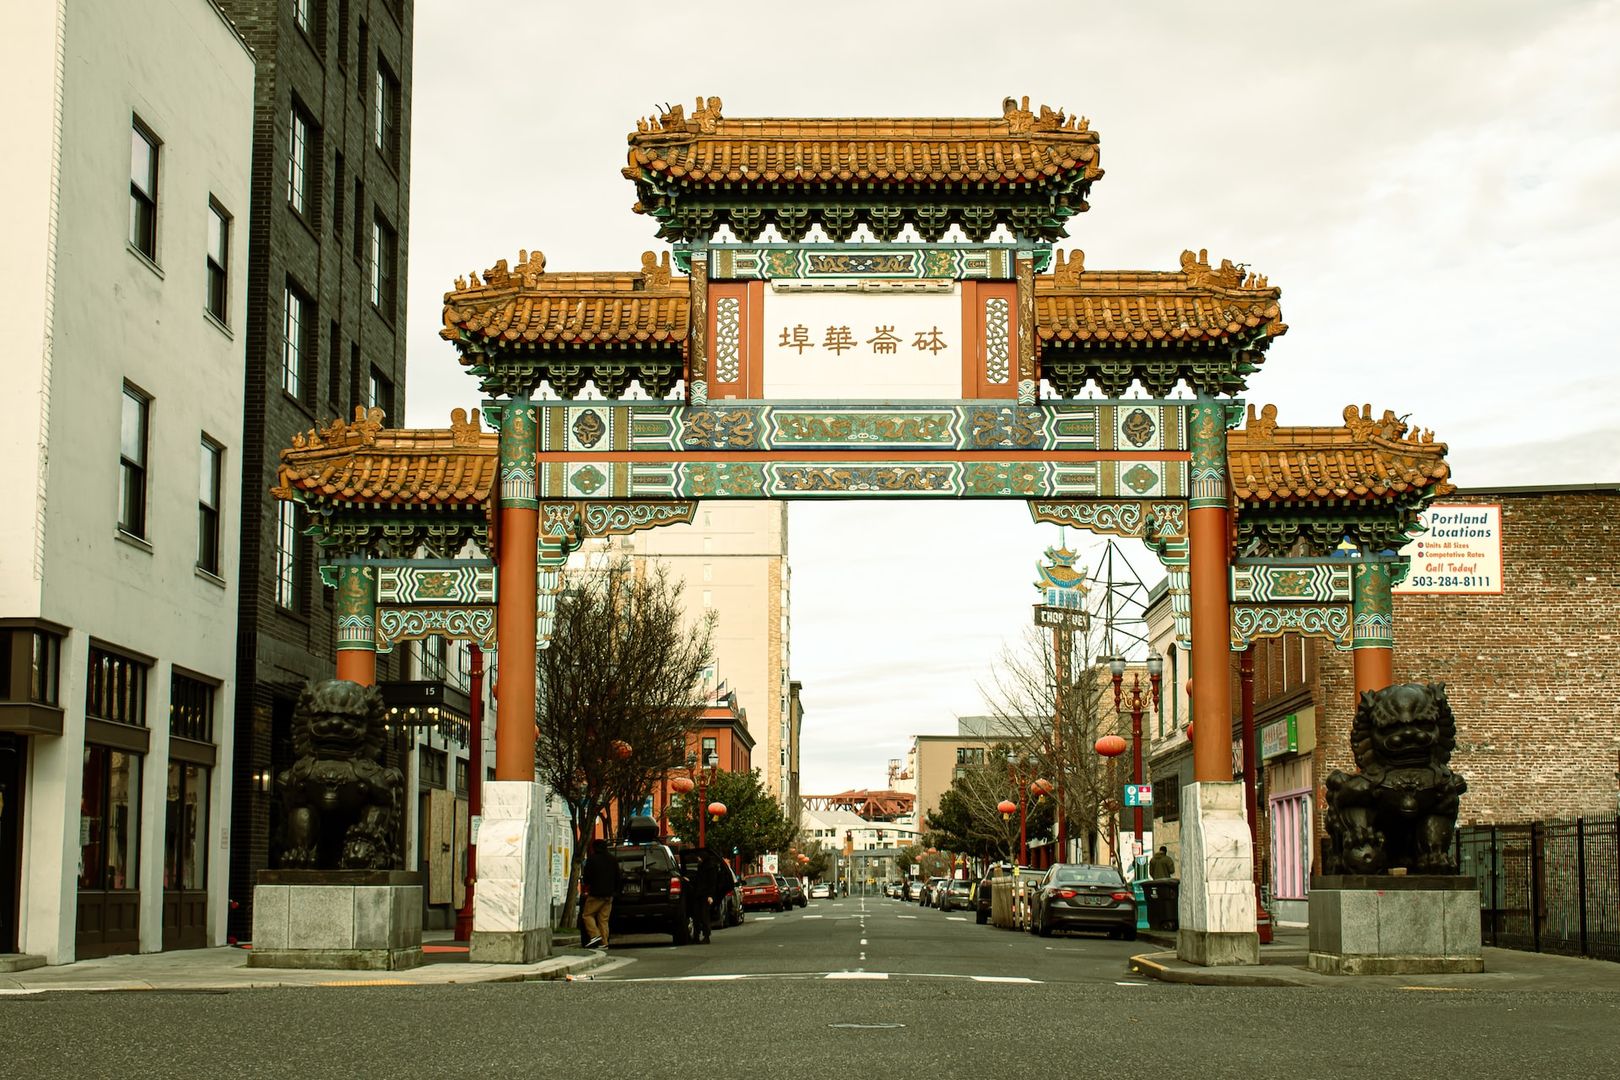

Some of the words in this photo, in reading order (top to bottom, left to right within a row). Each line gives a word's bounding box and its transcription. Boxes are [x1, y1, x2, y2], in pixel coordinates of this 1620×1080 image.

[1431, 513, 1488, 524] Portland
[1431, 526, 1491, 537] Locations
[1425, 563, 1443, 573] Call
[1448, 563, 1477, 574] Today!
[1412, 577, 1490, 586] 503-284-8111
[1041, 611, 1064, 623] CHOP
[425, 687, 435, 695] 15
